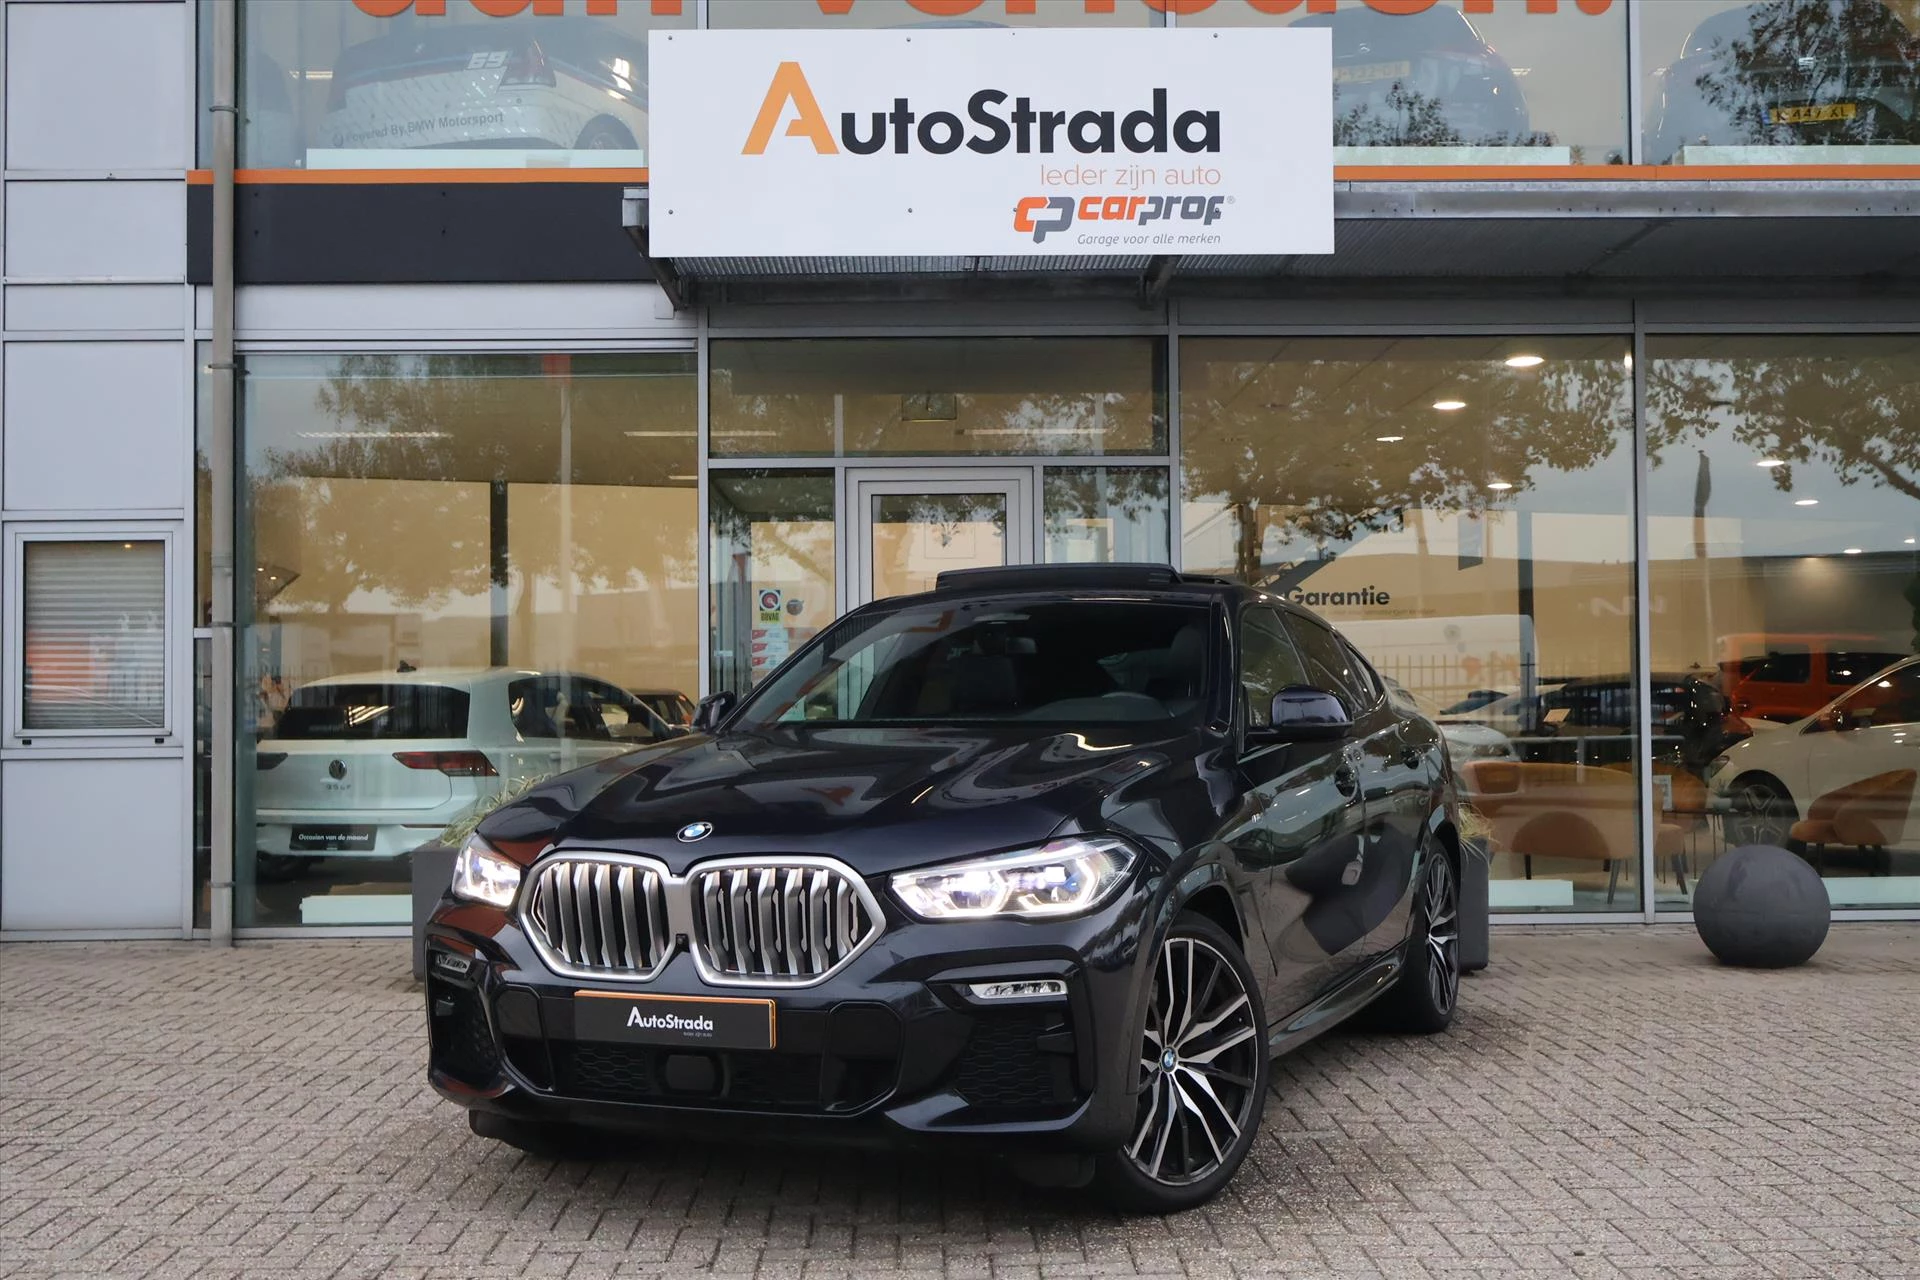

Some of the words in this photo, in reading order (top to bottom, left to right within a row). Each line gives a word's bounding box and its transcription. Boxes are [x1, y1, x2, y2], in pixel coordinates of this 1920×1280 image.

[741, 61, 1220, 155] AutoStrada
[407, 119, 436, 133] BMW
[439, 112, 505, 127] Motorsport
[1041, 164, 1107, 186] Ieder
[1116, 164, 1156, 190] zijn
[1164, 165, 1221, 186] auto
[1077, 233, 1120, 247] Garage
[1123, 235, 1149, 245] voor
[1152, 233, 1174, 245] alle
[1177, 233, 1221, 245] merken
[1286, 585, 1390, 606] Garantie
[298, 833, 325, 841] Occasion
[337, 833, 346, 841] de
[346, 833, 369, 841] maand
[626, 1006, 714, 1031] AutoStrada
